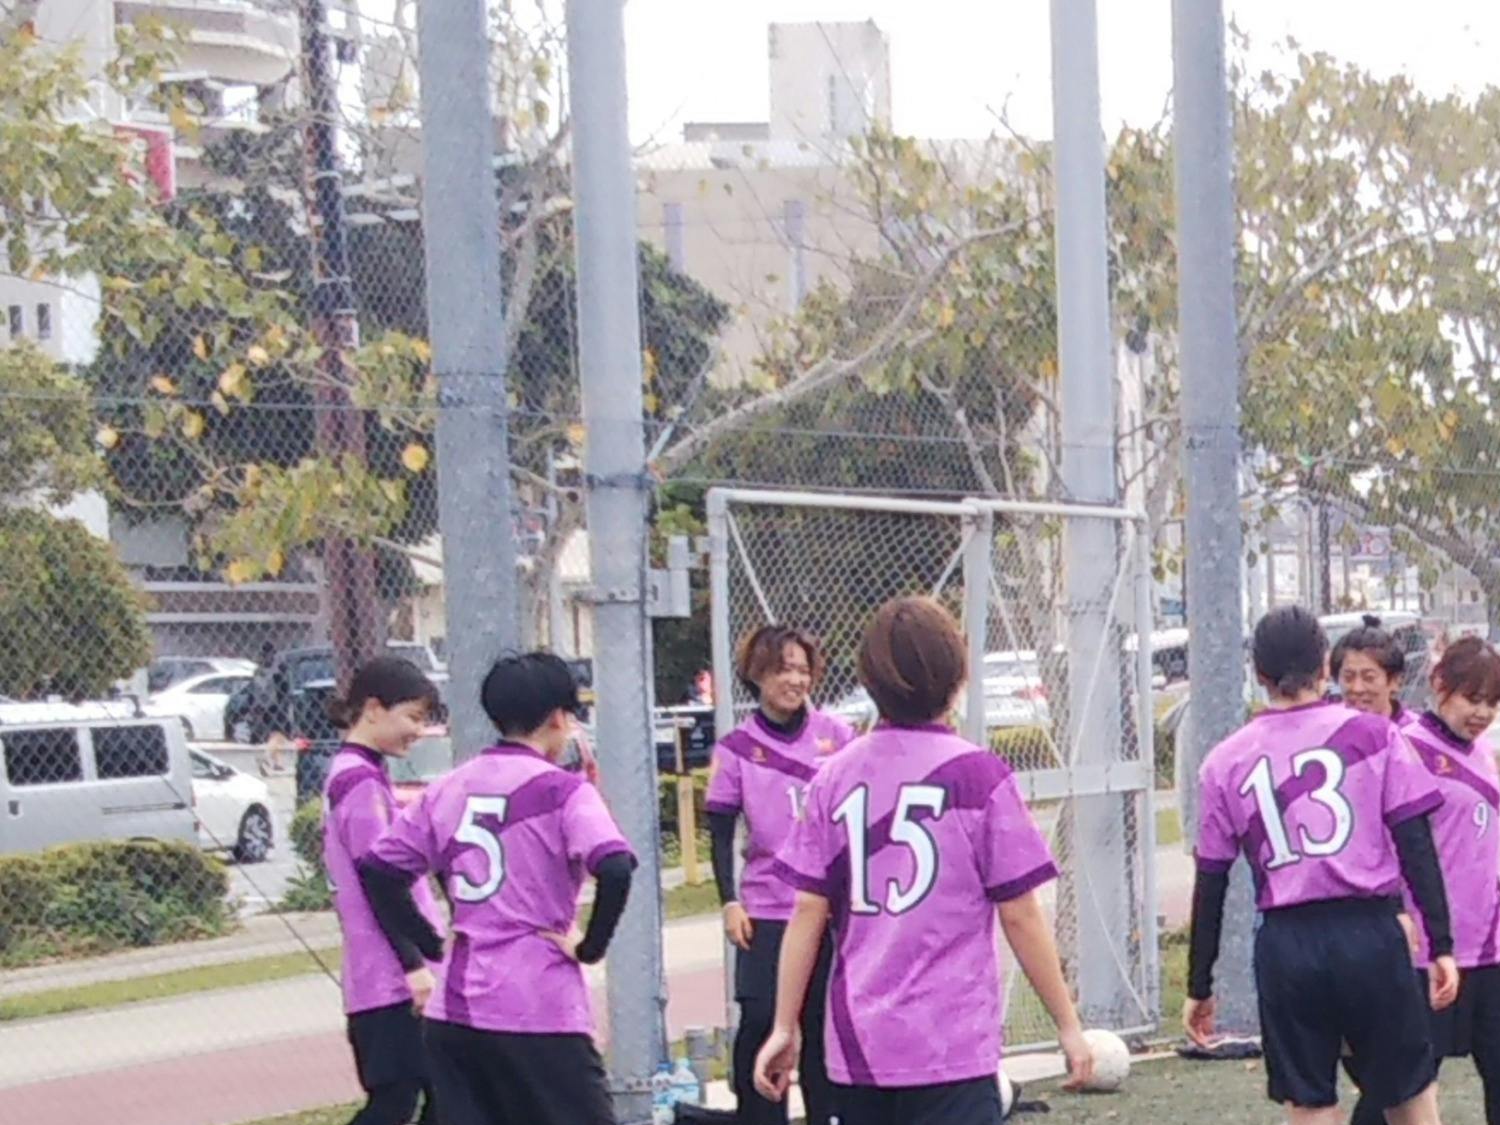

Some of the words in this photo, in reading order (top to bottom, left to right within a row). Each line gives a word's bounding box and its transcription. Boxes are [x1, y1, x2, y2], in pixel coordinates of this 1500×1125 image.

[449, 793, 508, 904] 5
[829, 781, 947, 917] 15
[1238, 746, 1353, 869] 13
[1472, 800, 1490, 841] 9
